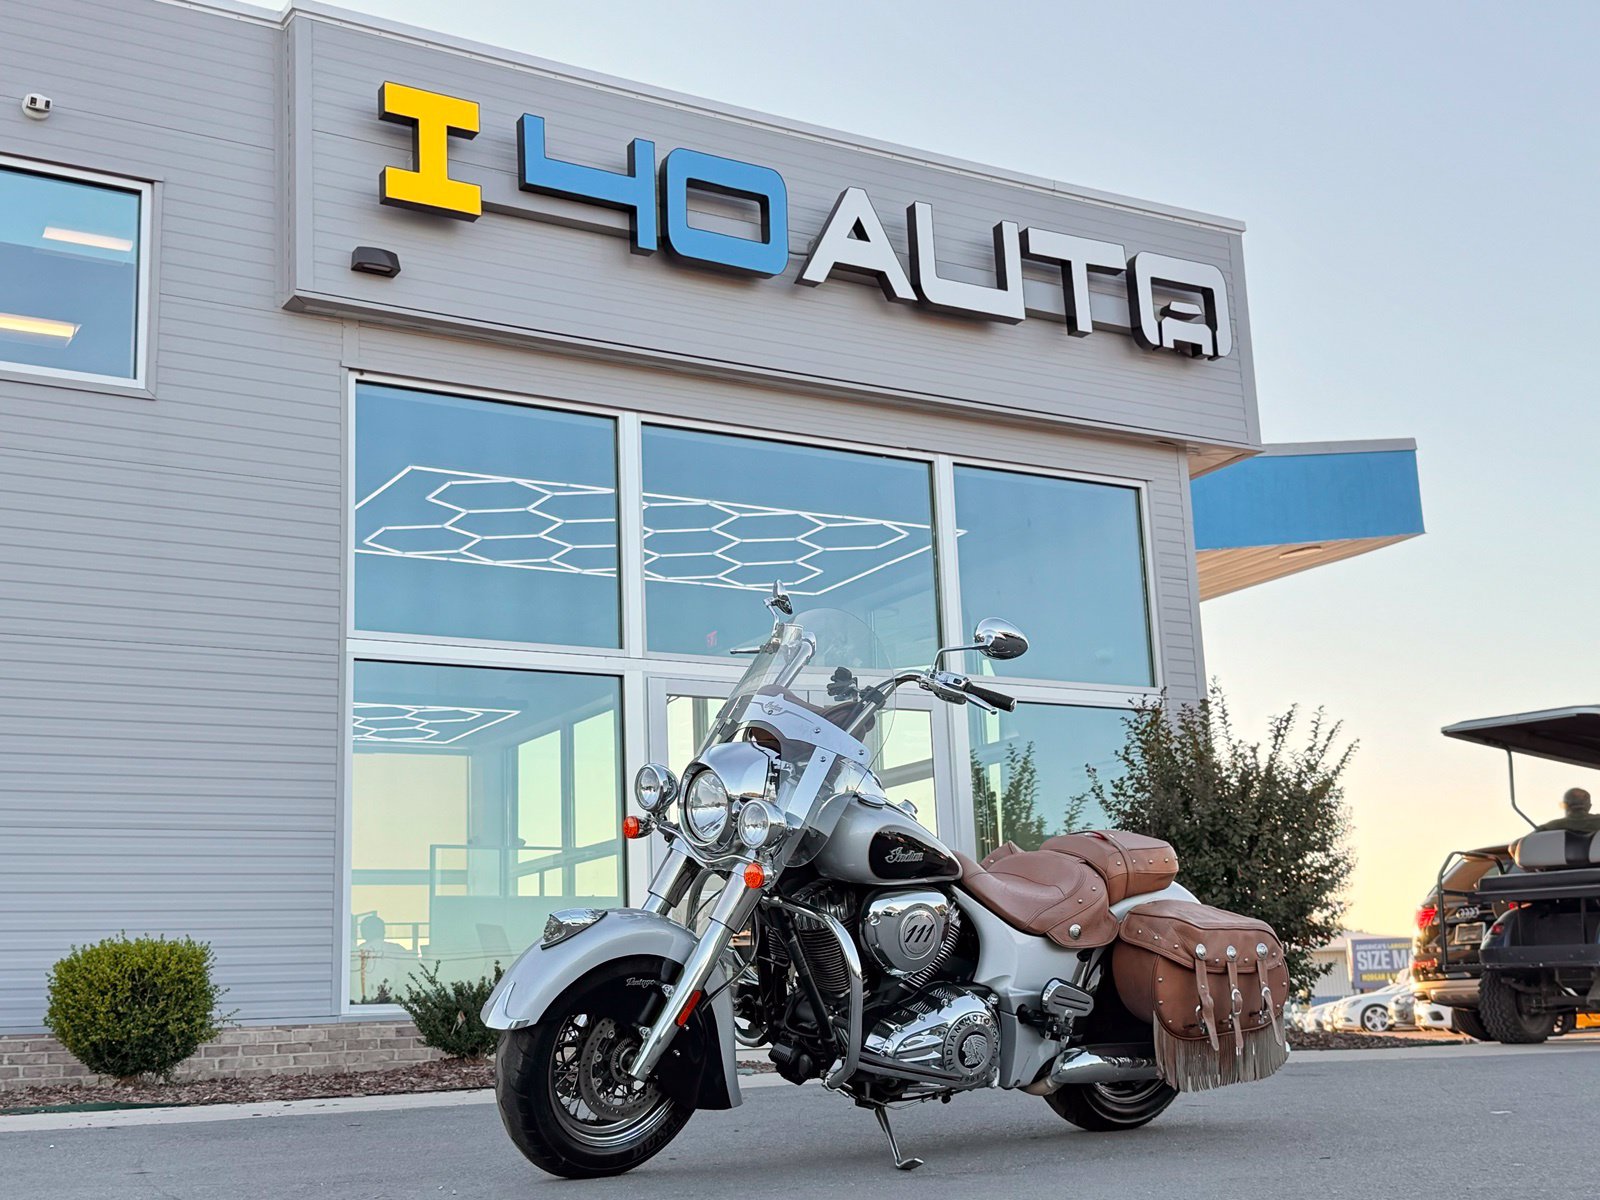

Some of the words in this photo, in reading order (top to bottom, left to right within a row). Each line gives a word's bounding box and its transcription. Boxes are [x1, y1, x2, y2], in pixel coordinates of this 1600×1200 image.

[795, 186, 1233, 361] AUTO
[885, 846, 924, 863] Indian
[904, 923, 935, 943] 111
[1357, 950, 1391, 971] SIZE
